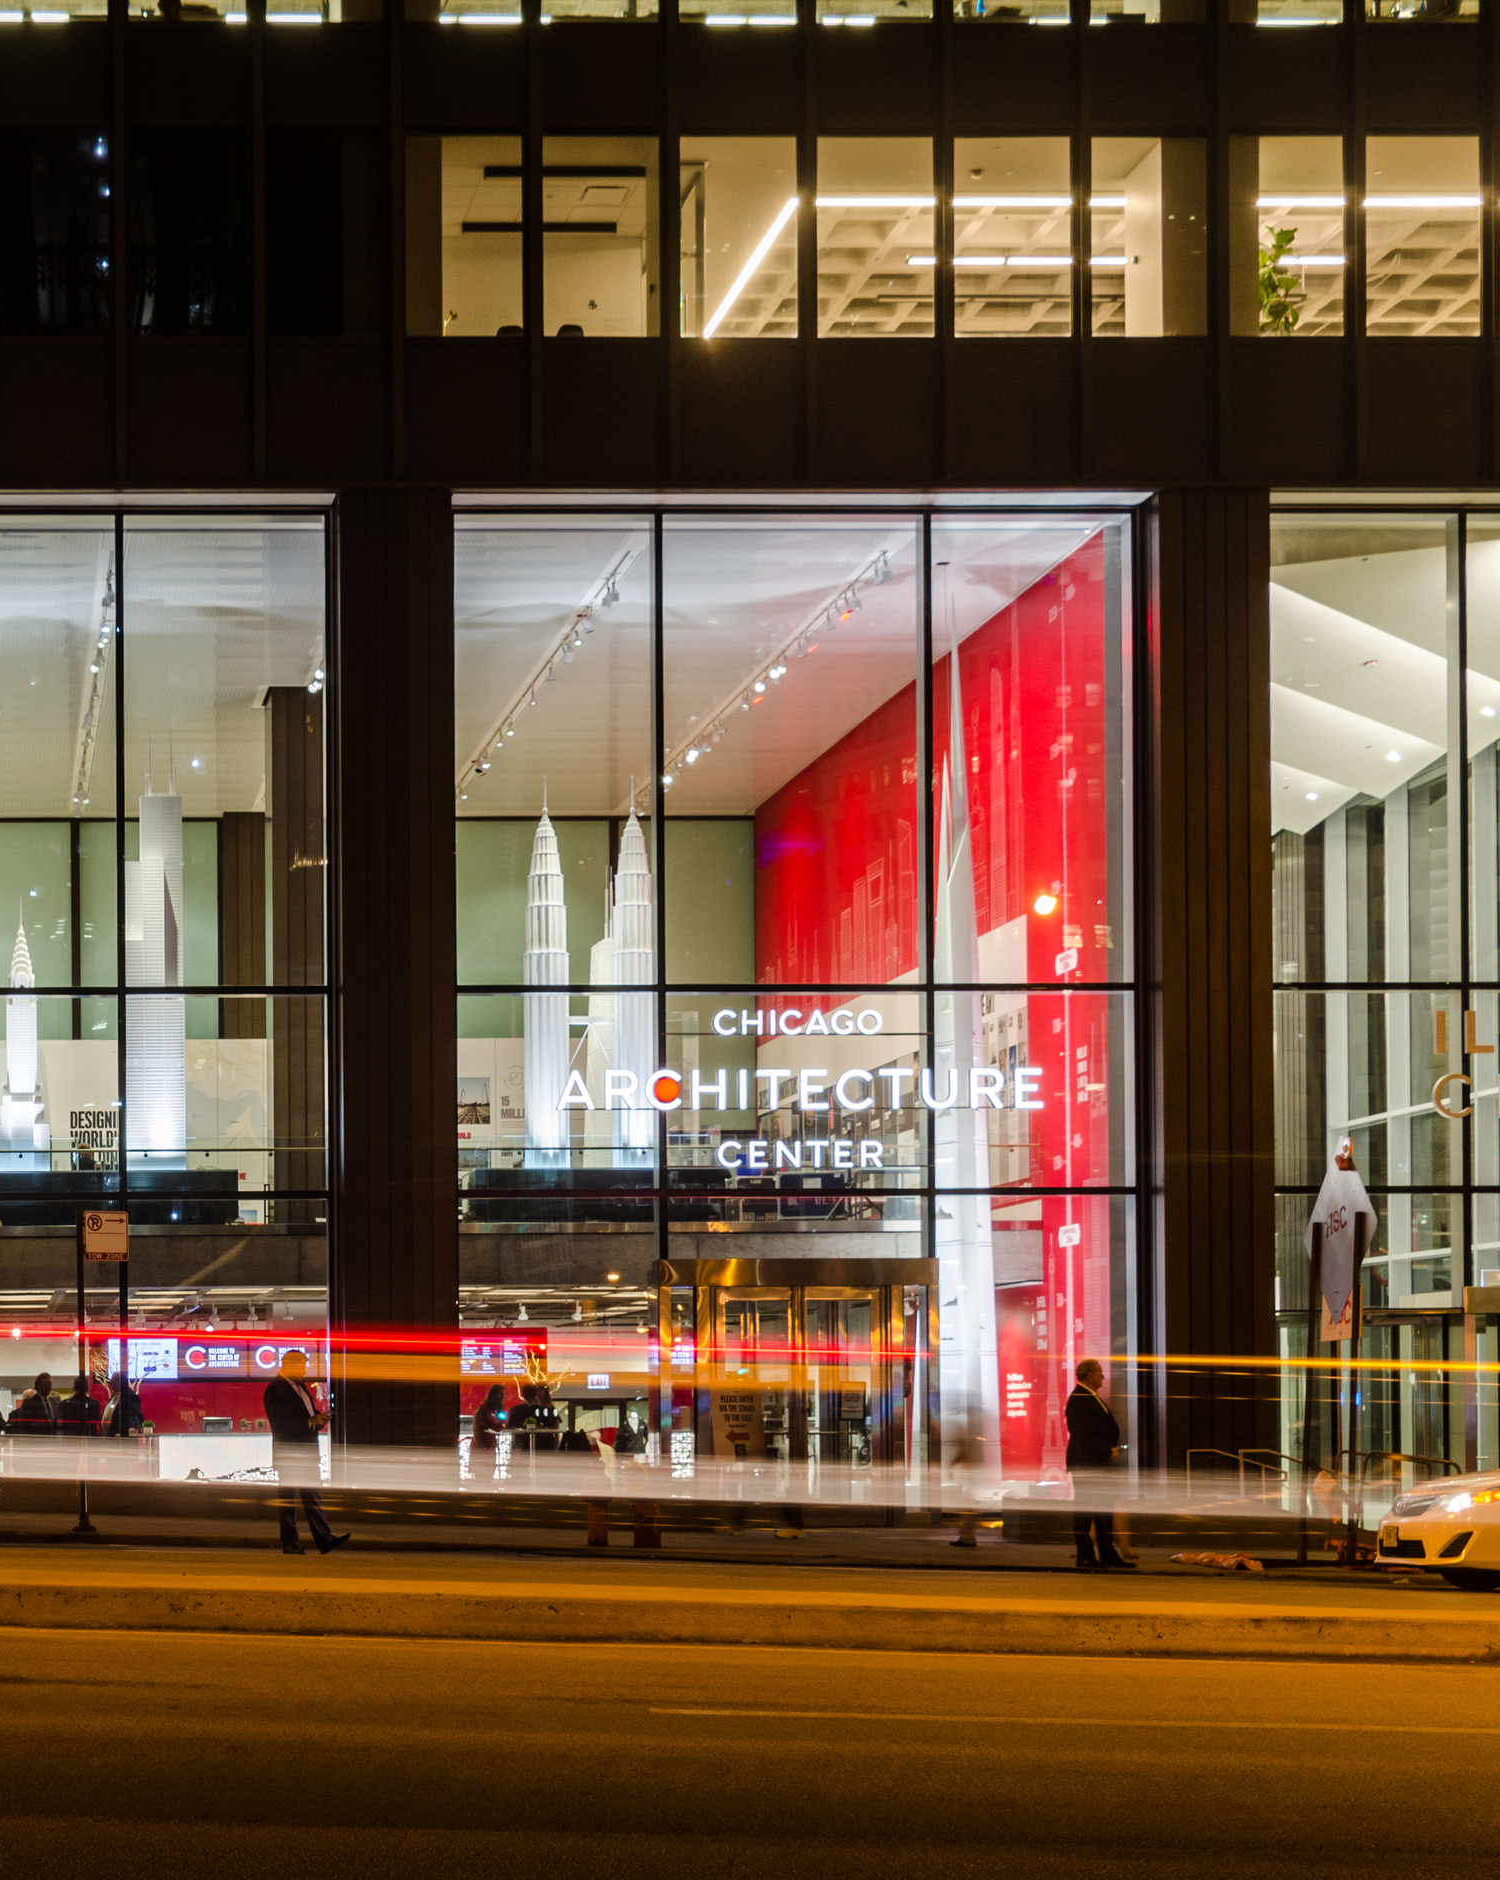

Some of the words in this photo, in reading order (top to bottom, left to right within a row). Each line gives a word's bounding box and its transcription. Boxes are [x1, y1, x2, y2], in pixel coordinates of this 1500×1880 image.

[713, 1008, 884, 1037] CHICAGO
[556, 1067, 1046, 1110] ARCHITECTURE
[501, 1096, 510, 1107] 15
[70, 1111, 118, 1129] DESIGNI
[716, 1139, 884, 1169] CENTER
[720, 1395, 738, 1403] PLEASE
[738, 1395, 754, 1403] ENTER
[731, 1414, 740, 1422] THE
[740, 1414, 753, 1422] EAST
